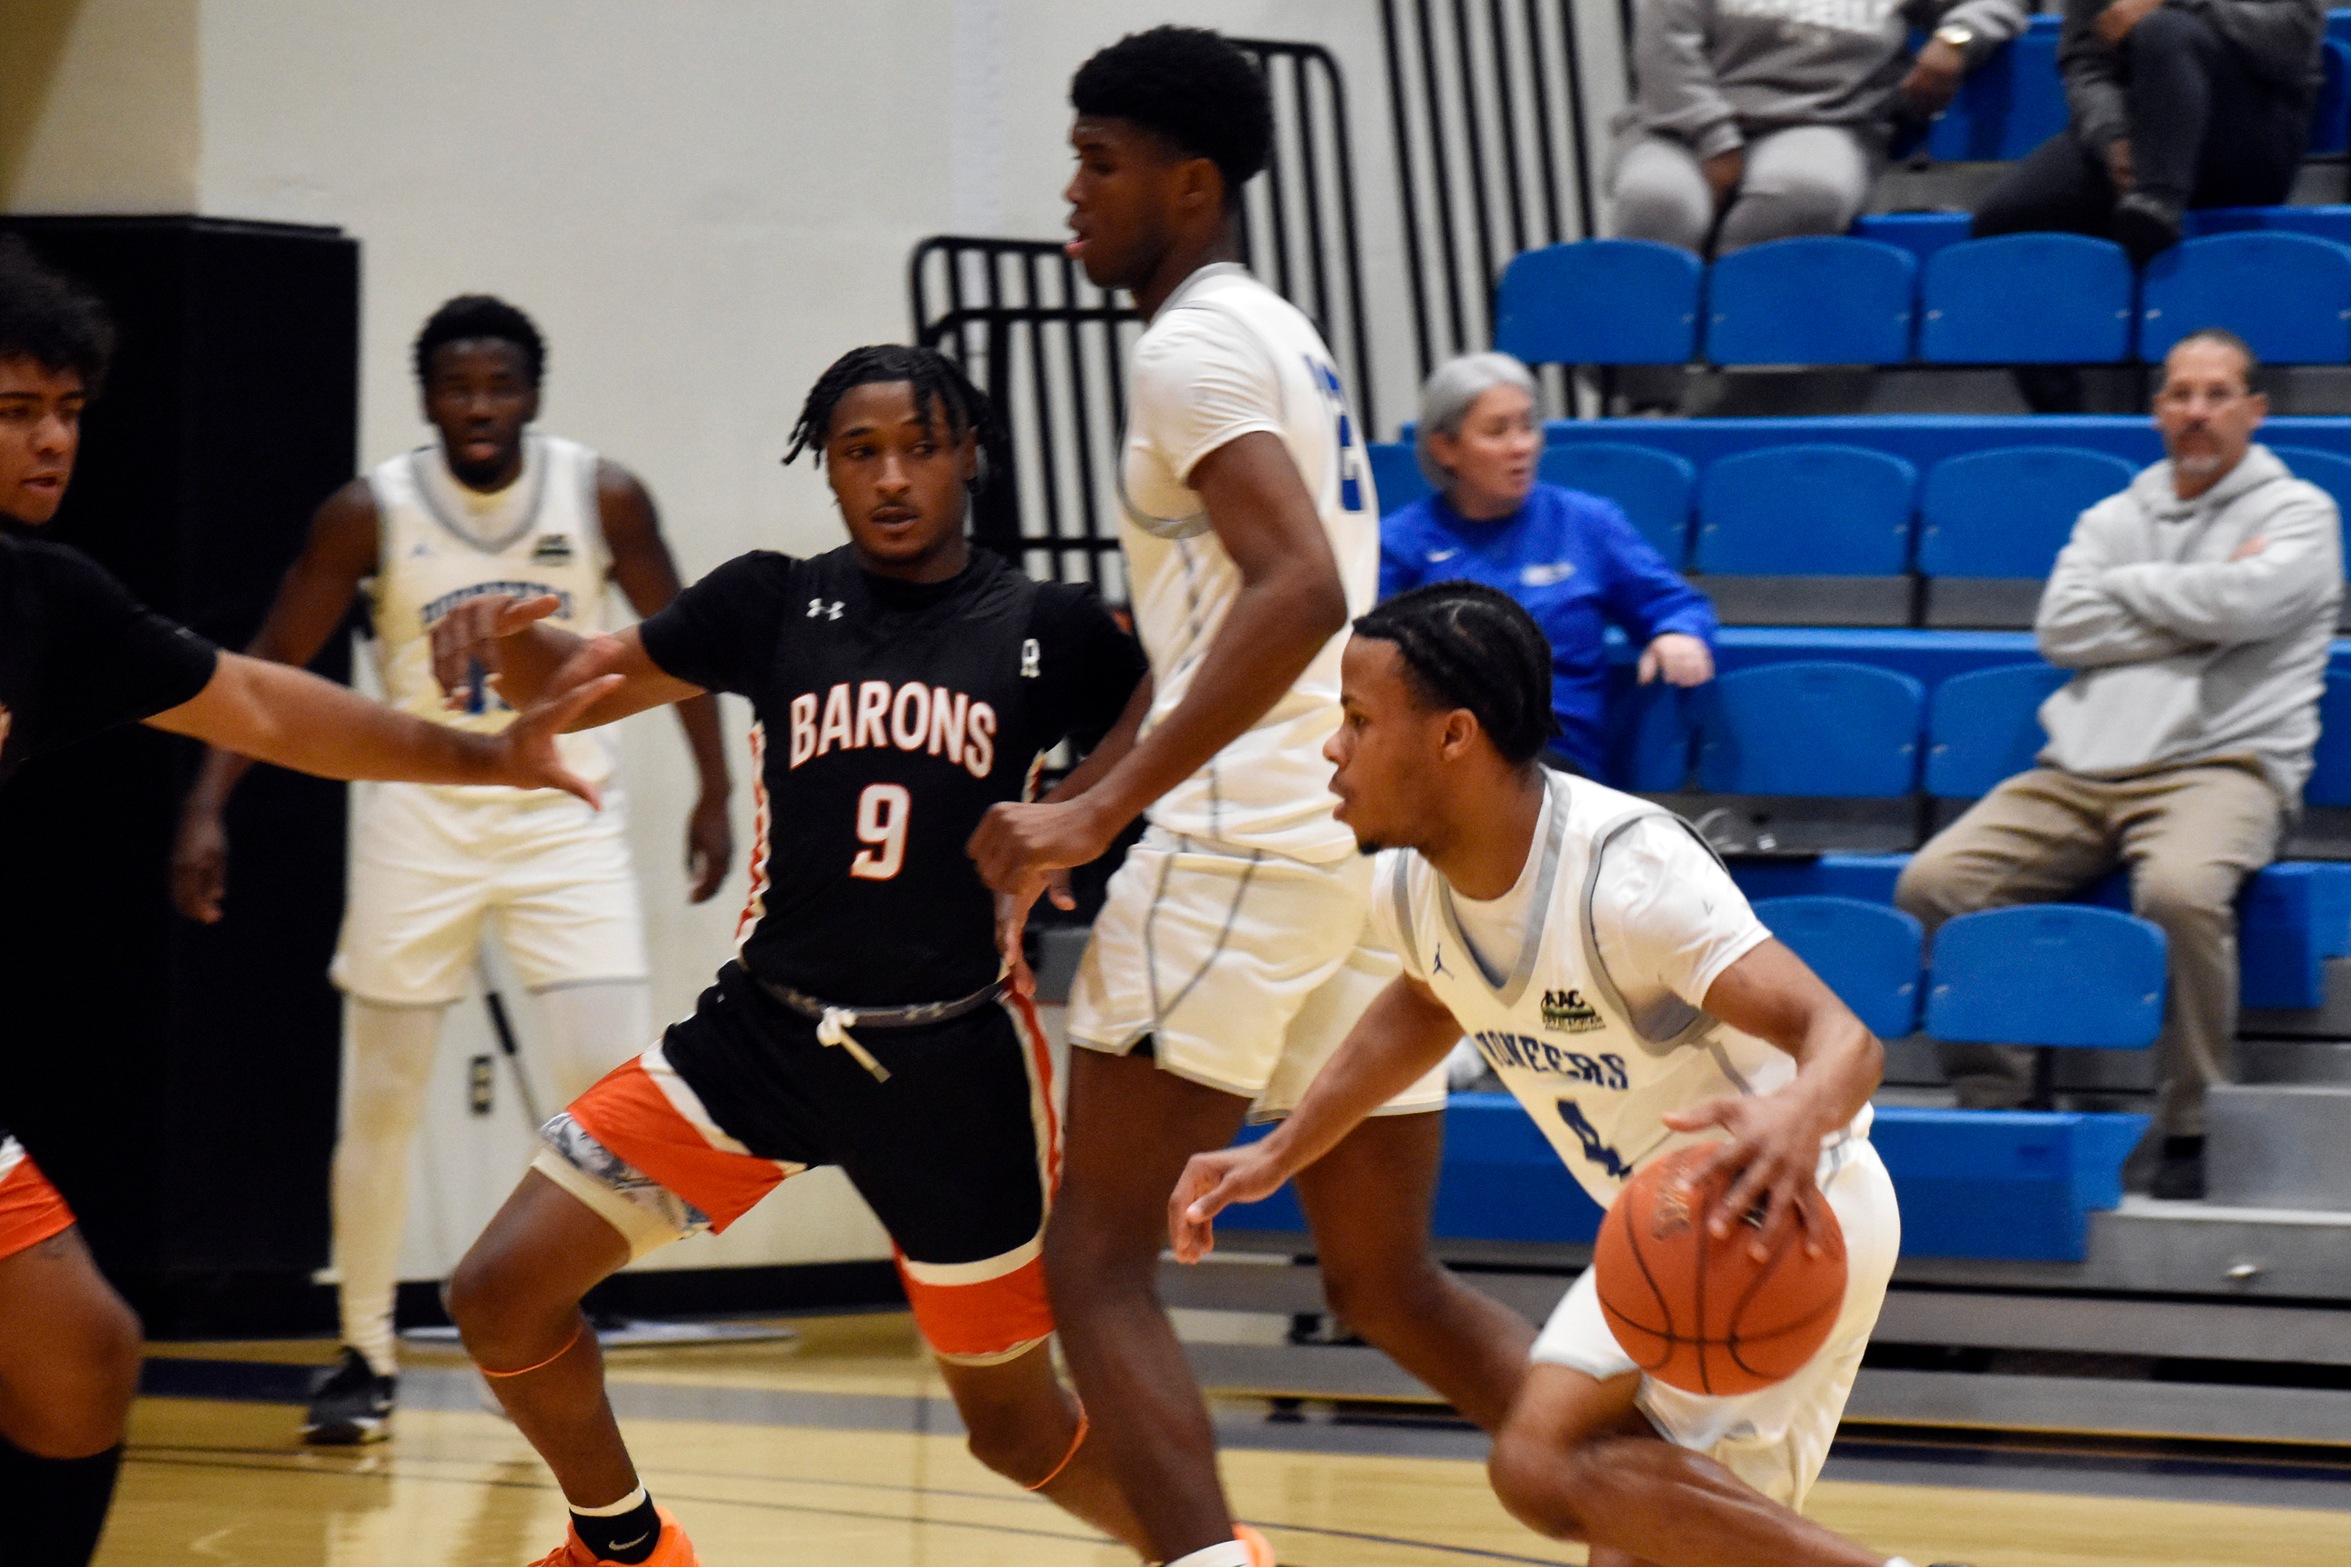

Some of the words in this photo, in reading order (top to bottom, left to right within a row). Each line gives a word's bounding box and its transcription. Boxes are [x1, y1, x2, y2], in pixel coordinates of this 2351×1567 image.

[789, 680, 998, 779] BARONS
[849, 782, 912, 882] 9
[1475, 1029, 1629, 1091] IONEERS
